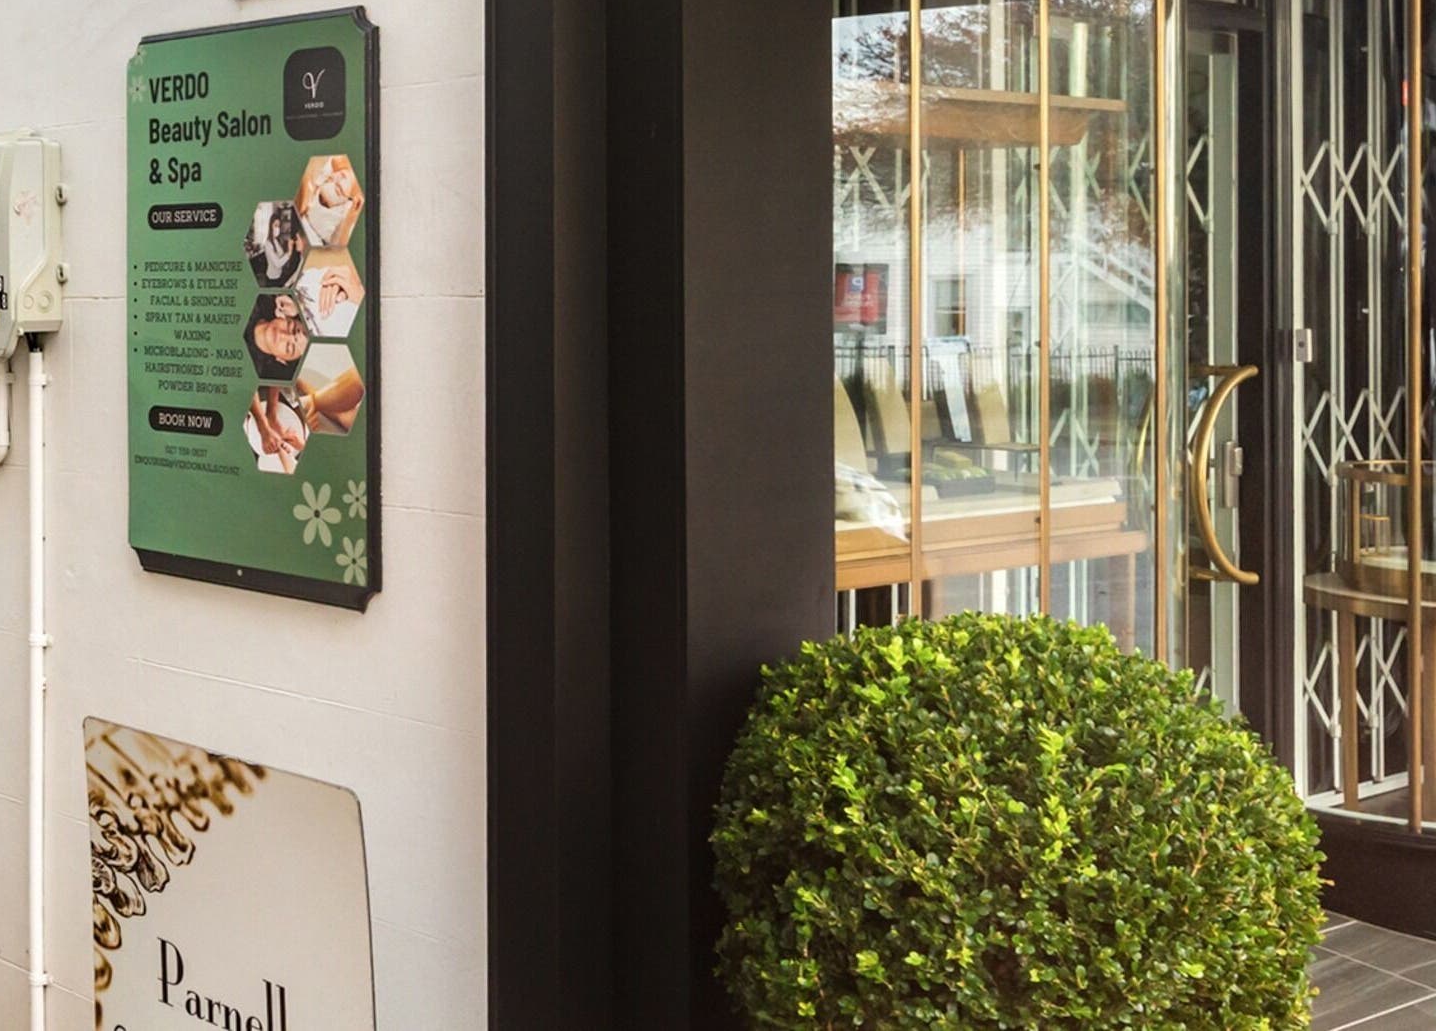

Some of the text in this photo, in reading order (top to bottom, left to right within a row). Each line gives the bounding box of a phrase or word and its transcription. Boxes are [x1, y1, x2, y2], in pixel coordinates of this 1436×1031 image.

[149, 71, 209, 104] VERDO
[149, 109, 271, 147] Beauty Salon
[149, 156, 202, 189] & Spa
[151, 209, 217, 224] OUR SERVICE
[144, 261, 185, 272] PEDICURE
[194, 261, 243, 272] MANICURE
[141, 278, 187, 289] EYEBROWS
[196, 278, 238, 289] EYELASH
[150, 295, 181, 306] FACIAL
[191, 296, 237, 307] SKINCARE
[145, 312, 173, 323] SPRAY
[175, 312, 194, 323] TAN
[203, 313, 242, 325] MAKEUP
[174, 330, 211, 341] WAXING
[144, 345, 209, 358] MICROBLADING
[215, 349, 244, 360] NANO
[145, 362, 204, 376] HAIRSTROKES
[211, 365, 243, 378] OMBRE
[158, 379, 228, 394] POWDER BROWS
[158, 413, 213, 429] BOOK NOW
